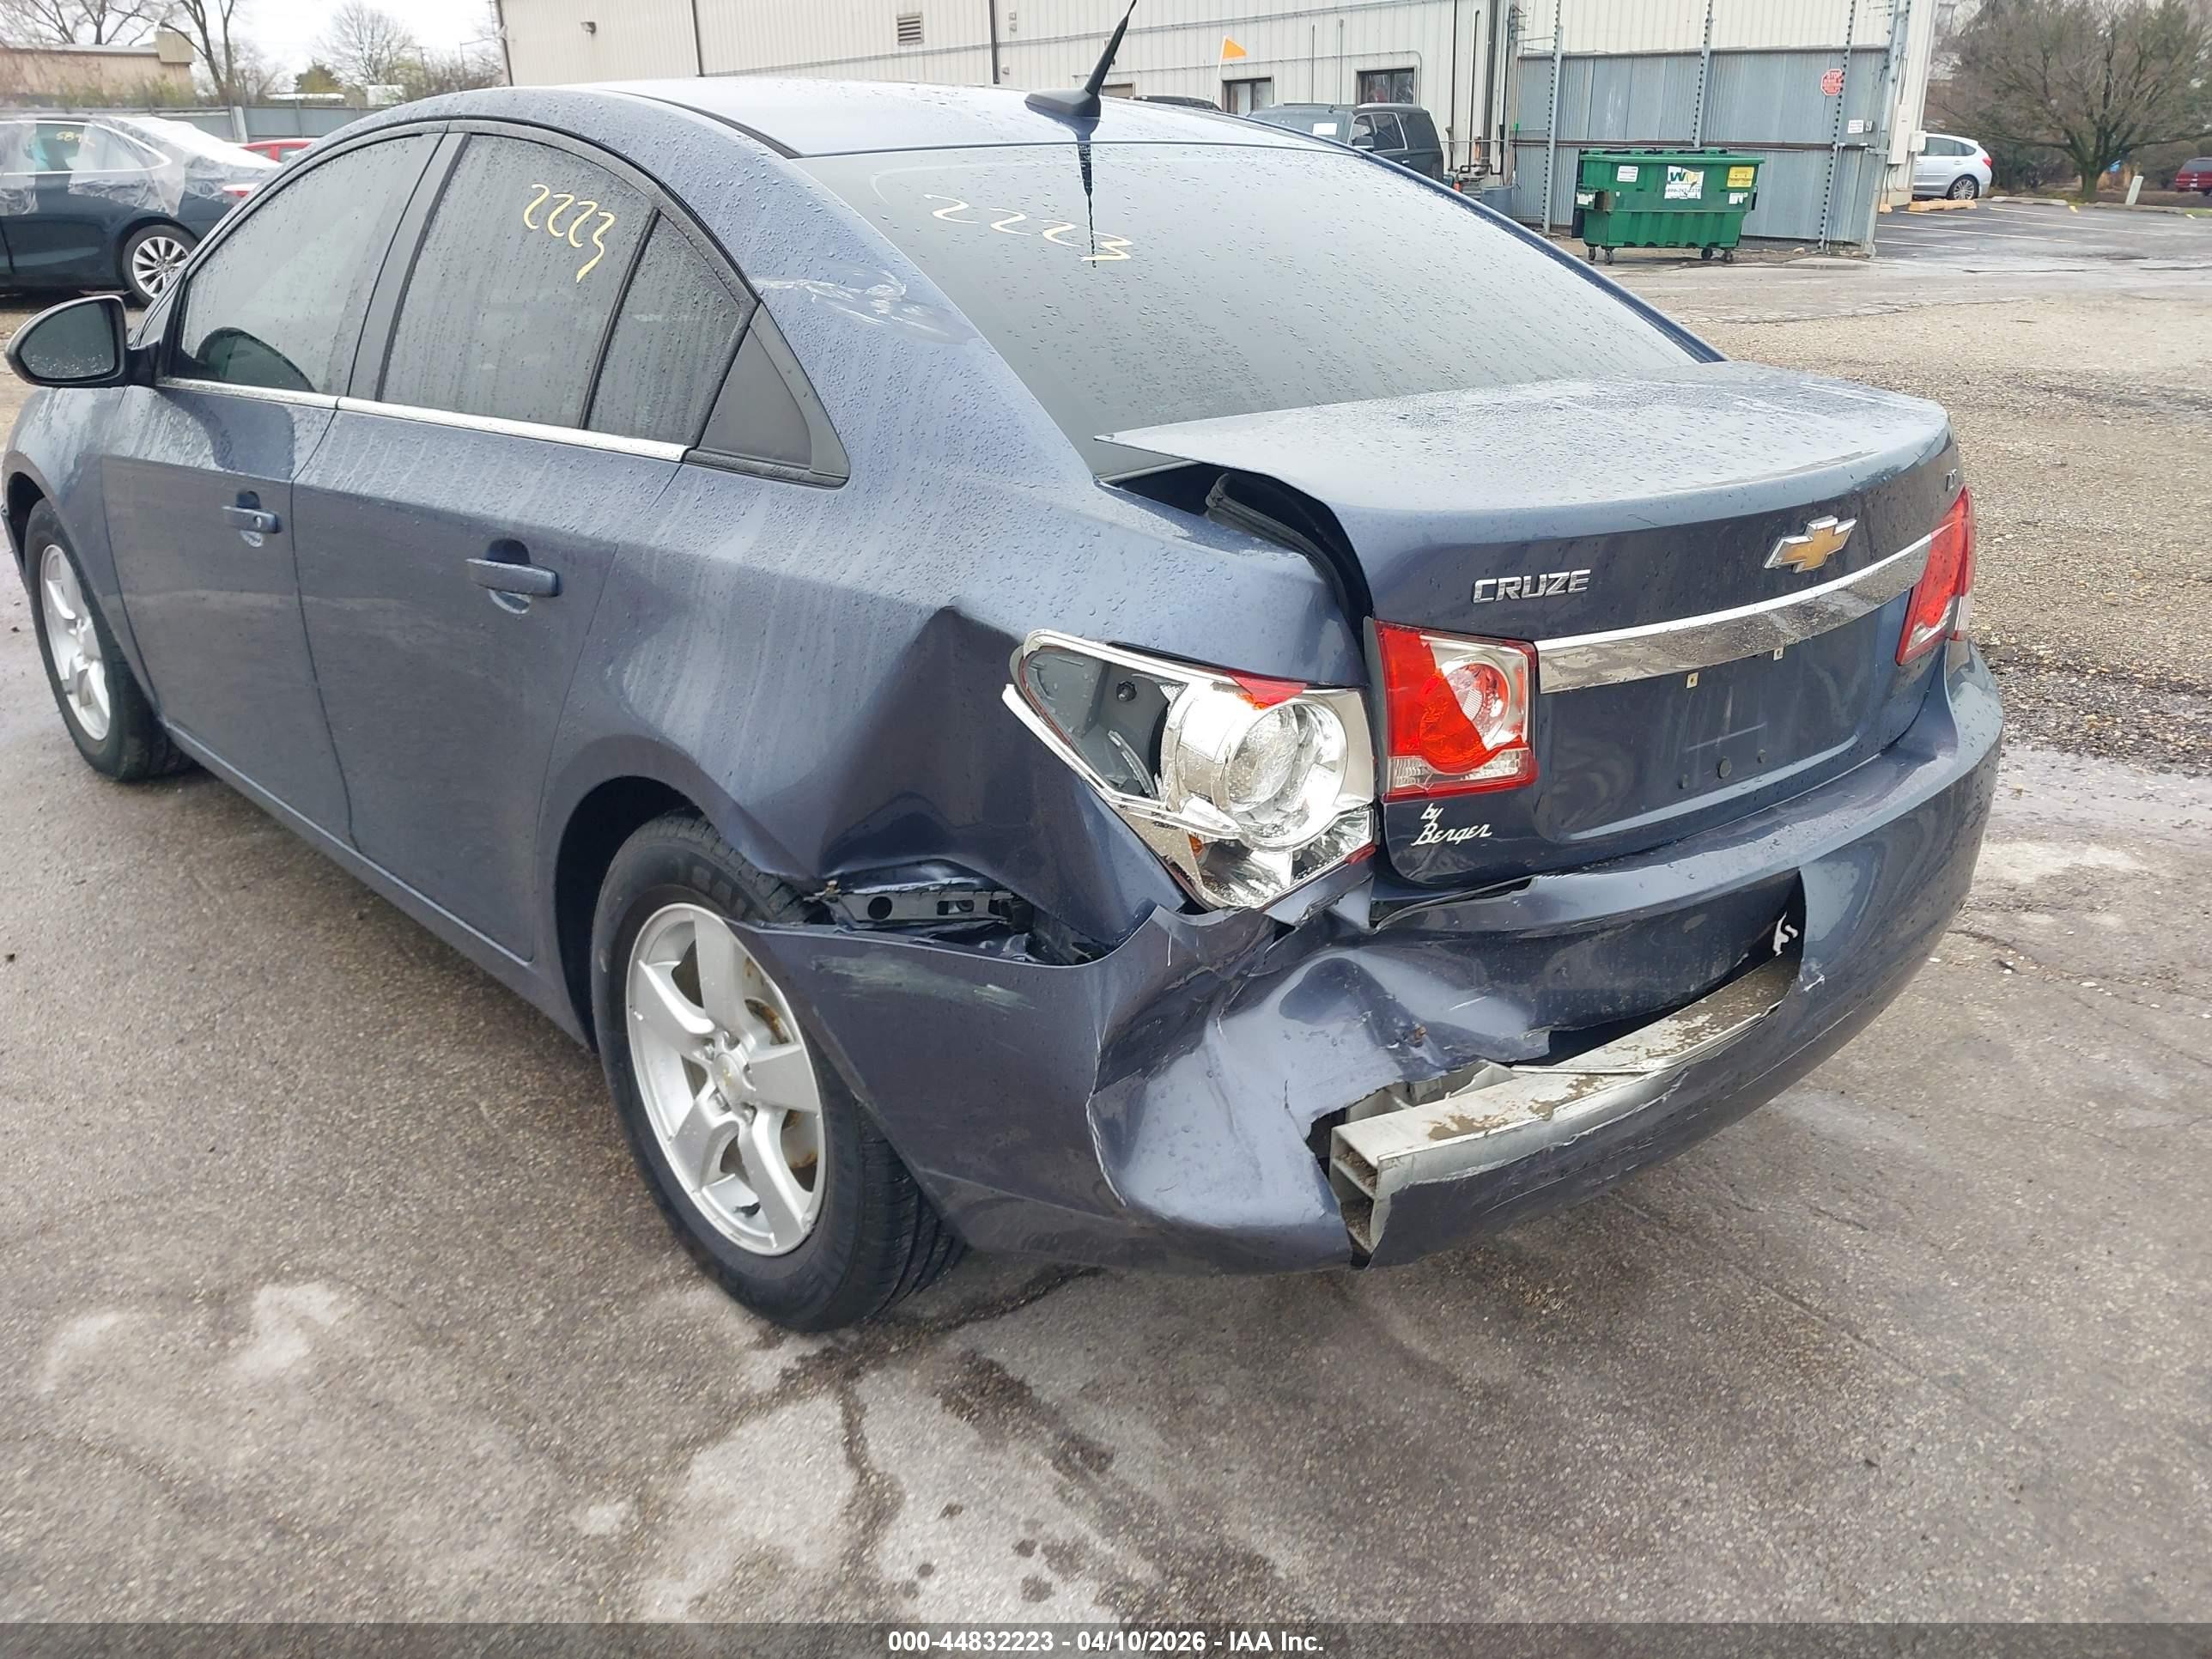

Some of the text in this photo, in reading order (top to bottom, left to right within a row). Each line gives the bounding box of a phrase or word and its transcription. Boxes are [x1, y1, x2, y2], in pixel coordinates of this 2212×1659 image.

[523, 183, 616, 283] 2223
[924, 193, 1134, 261] 2223
[1473, 568, 1591, 604] CRUZE
[1420, 803, 1444, 824] by
[1410, 823, 1492, 847] Berger
